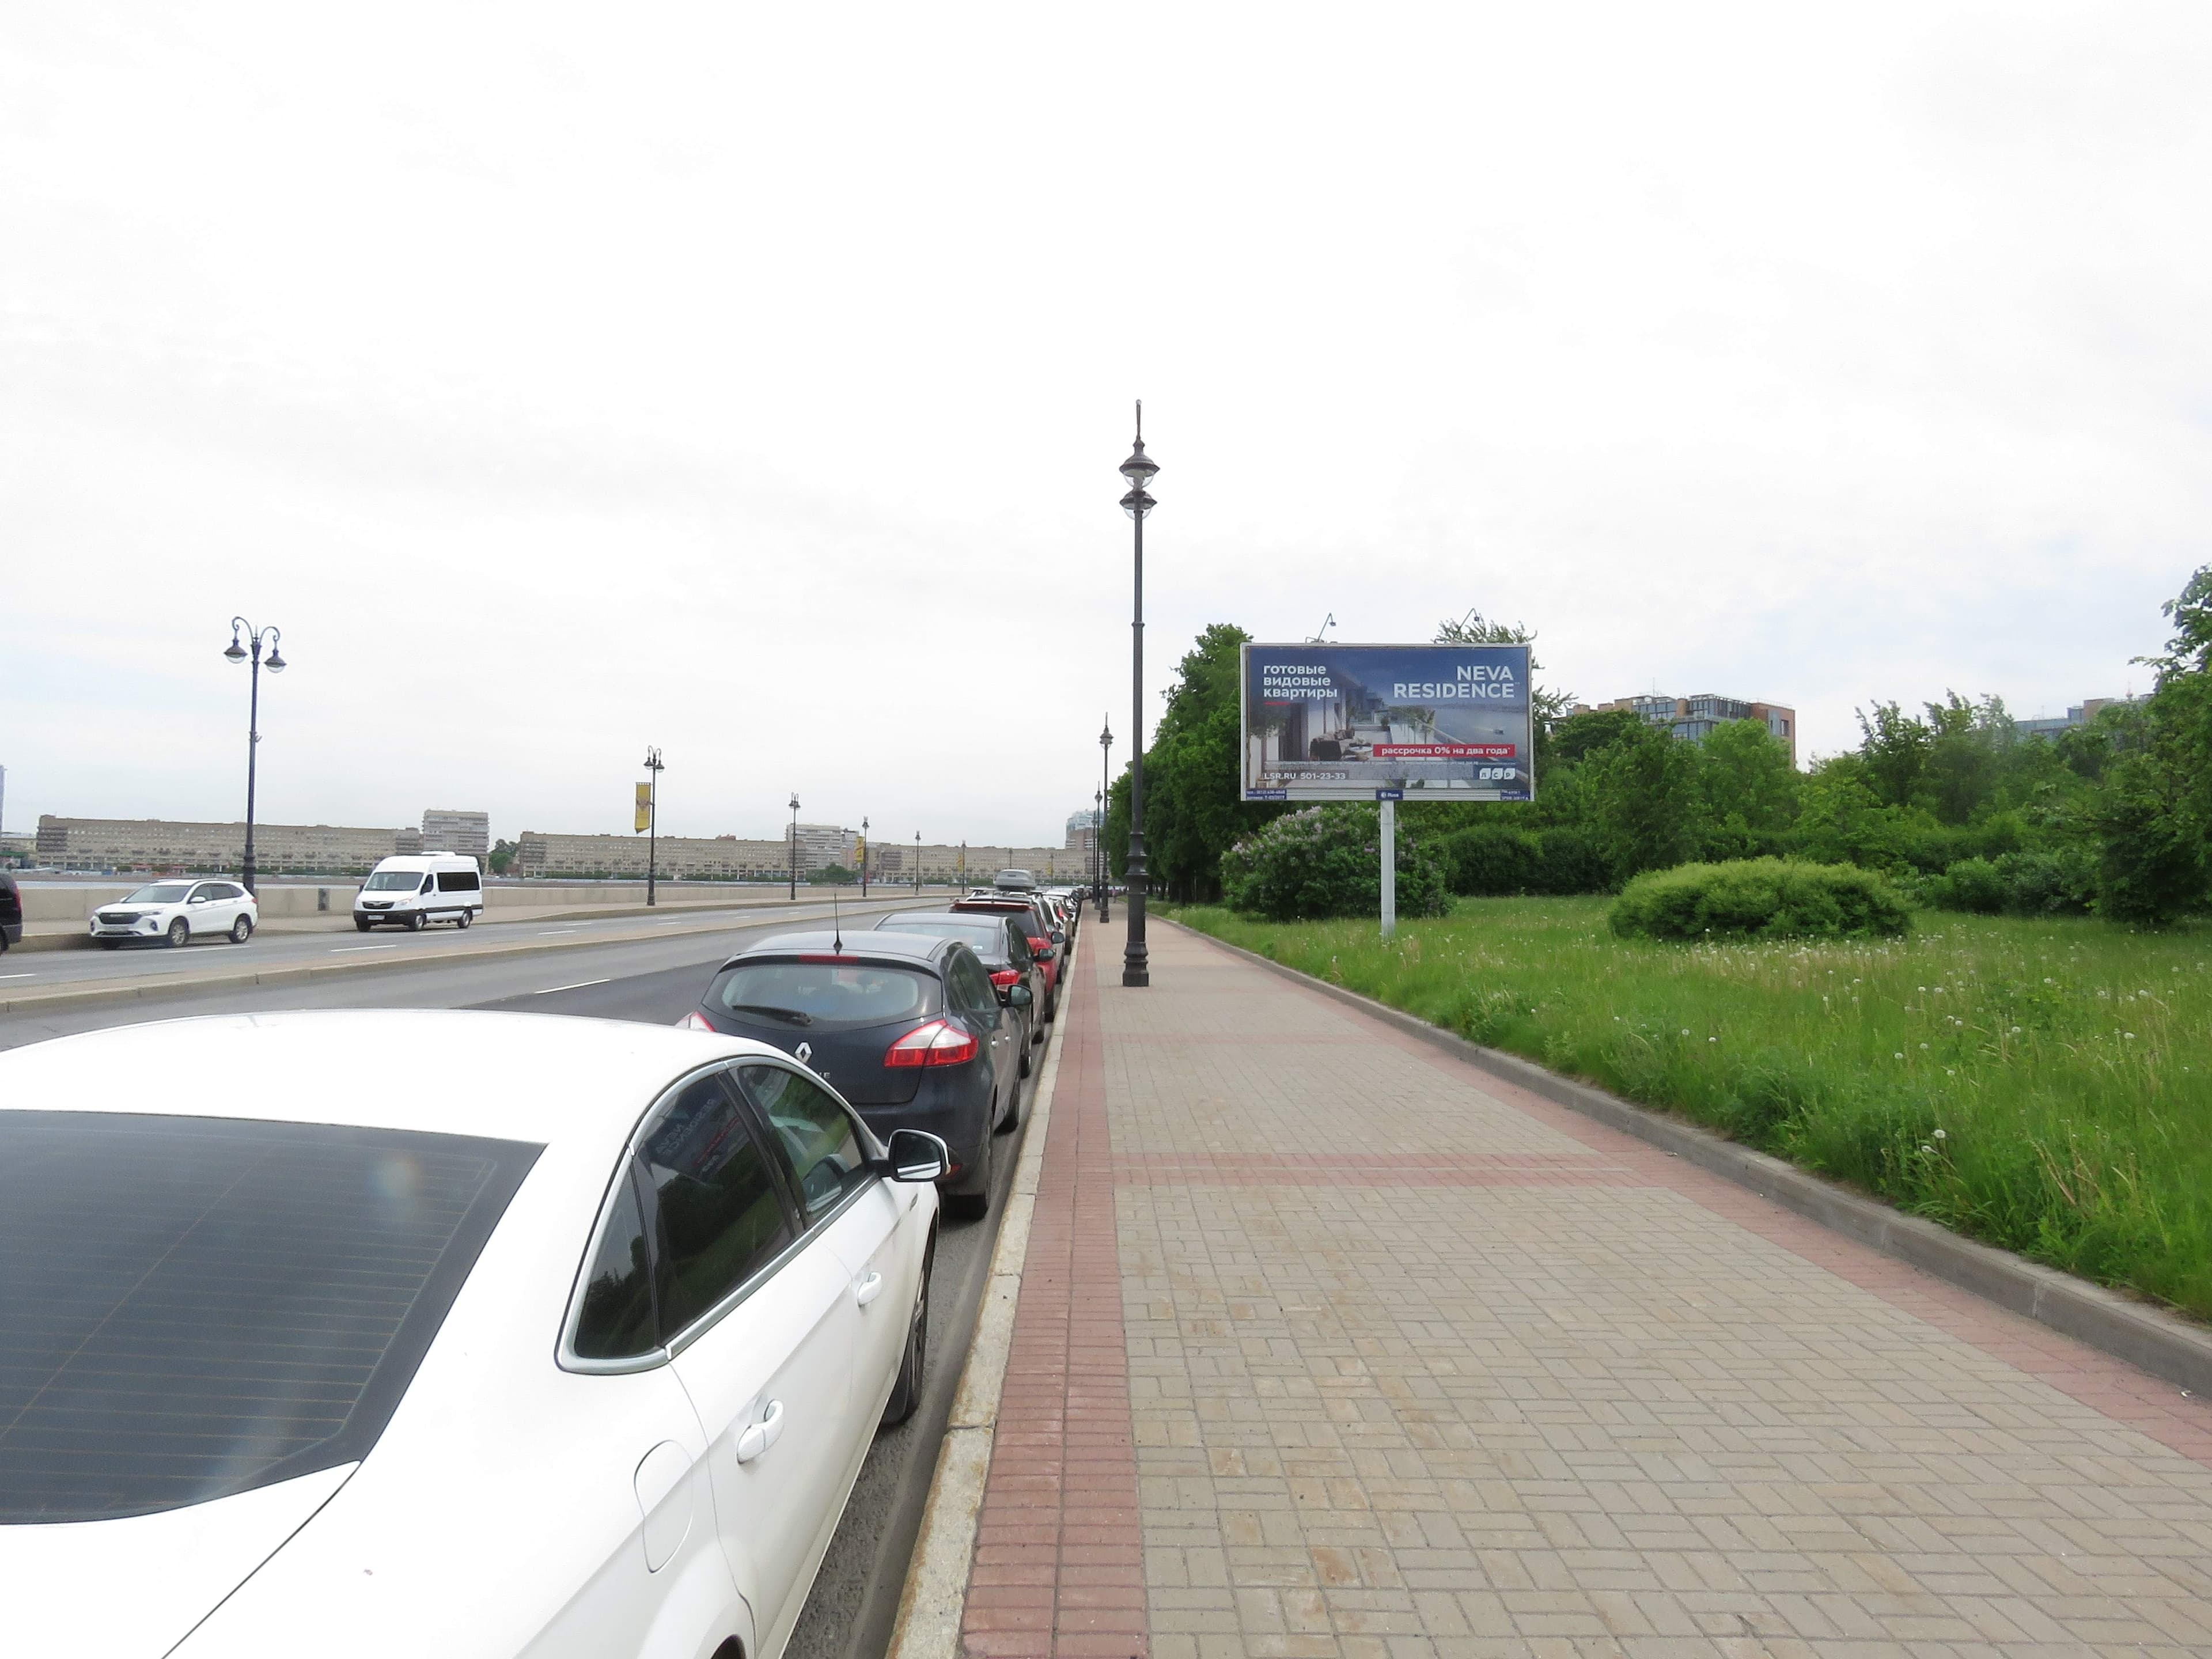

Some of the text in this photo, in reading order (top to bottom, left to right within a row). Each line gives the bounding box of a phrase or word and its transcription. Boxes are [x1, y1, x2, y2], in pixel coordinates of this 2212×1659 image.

[1263, 665, 1327, 675] готовые
[1457, 666, 1514, 681] NEVA
[1263, 677, 1331, 687] видовые
[1263, 688, 1338, 700] квартиры
[1393, 683, 1515, 699] RESIDENCE
[1382, 748, 1432, 756] рассрочка
